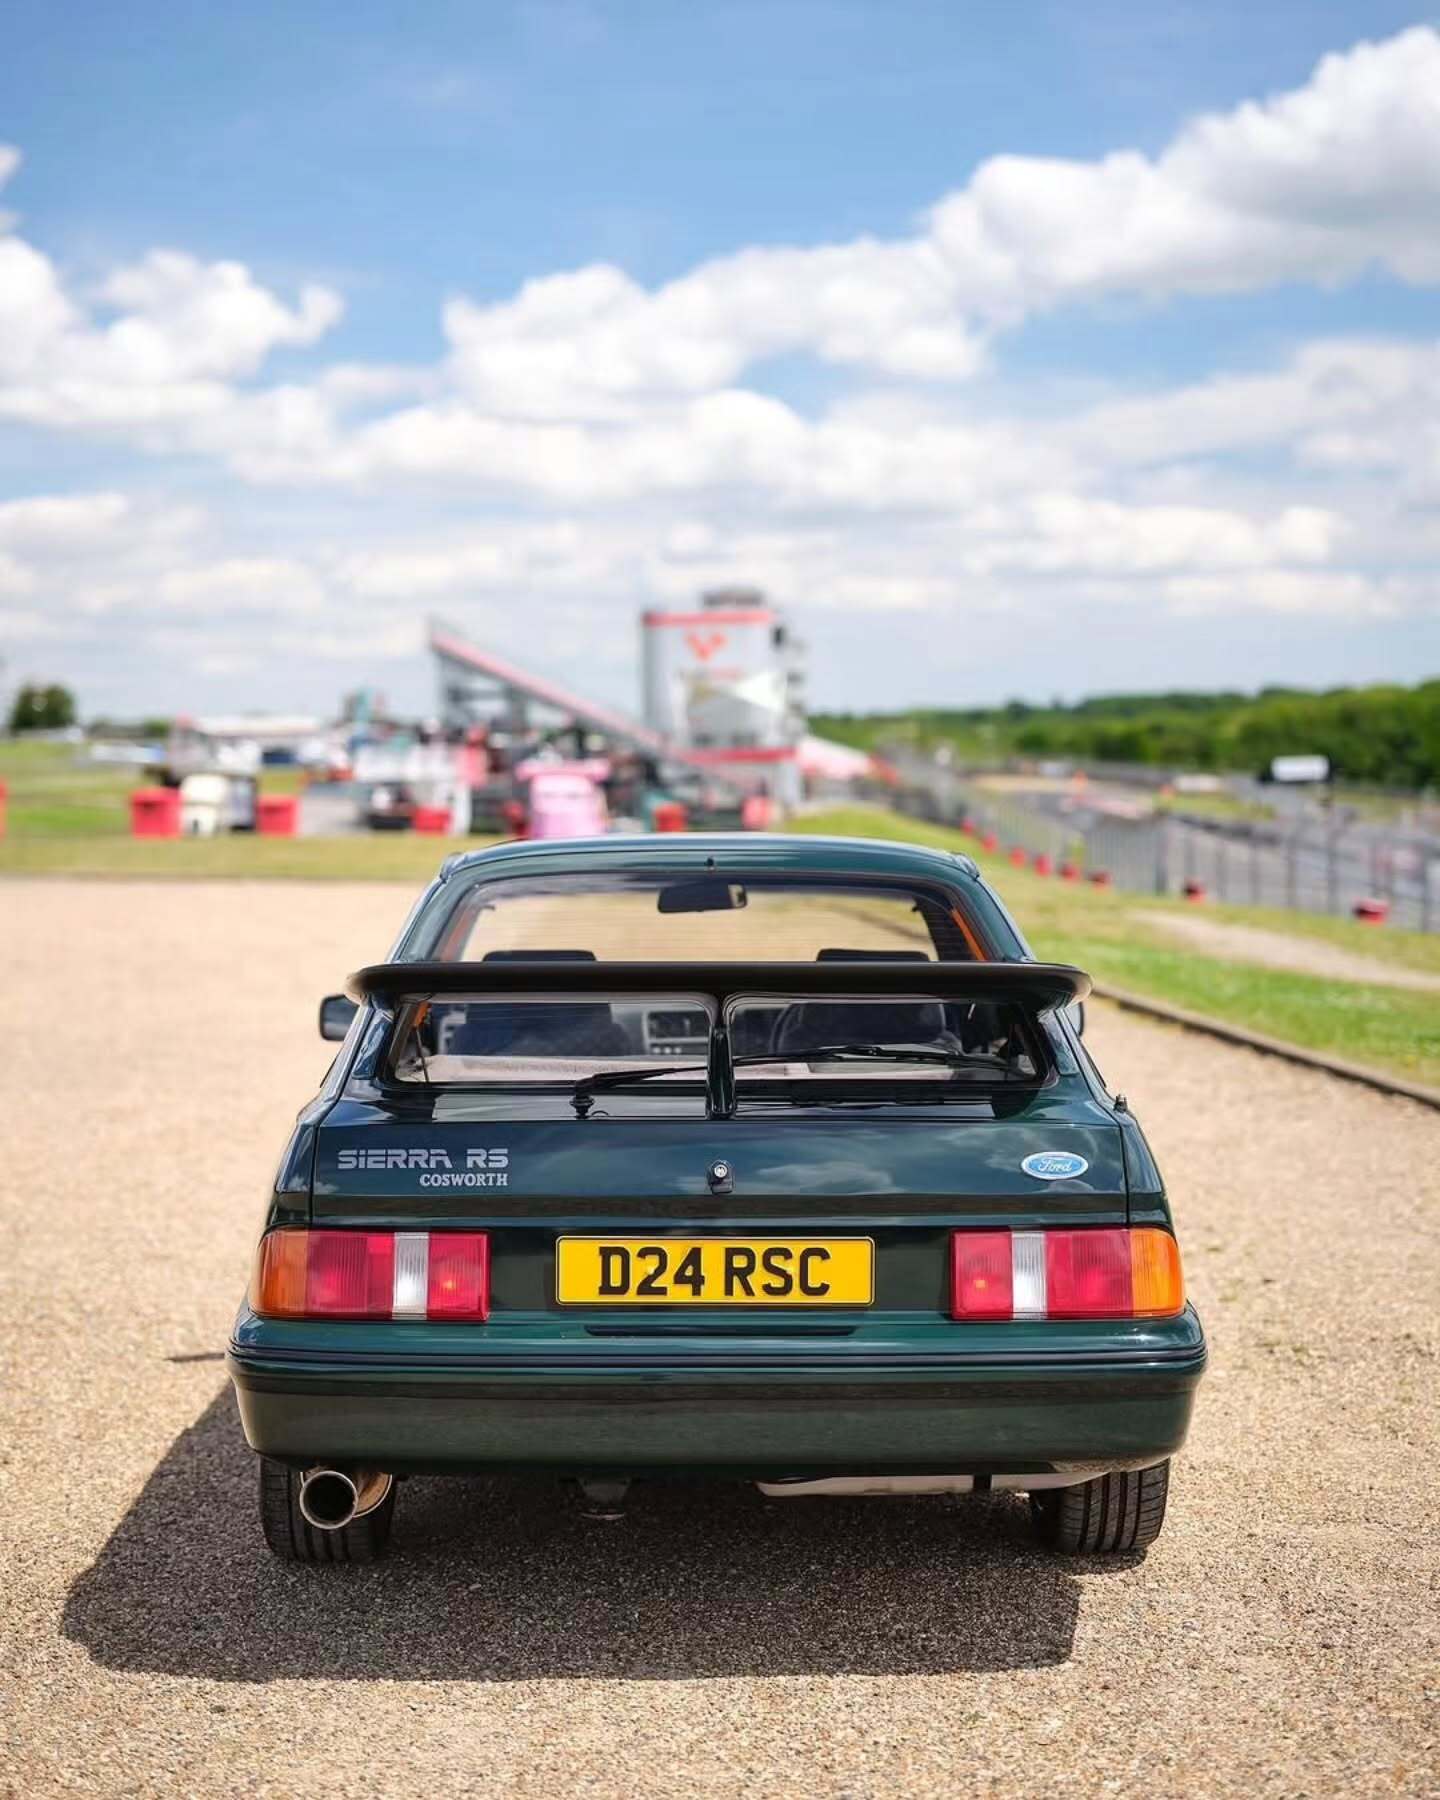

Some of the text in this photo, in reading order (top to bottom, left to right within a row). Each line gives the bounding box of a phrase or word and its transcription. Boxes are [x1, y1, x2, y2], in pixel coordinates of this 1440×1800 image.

[337, 1148, 509, 1169] SIERRA RS
[1038, 1158, 1073, 1172] Ford
[419, 1173, 508, 1187] COSWORTH
[598, 1246, 831, 1297] D24 RSC
